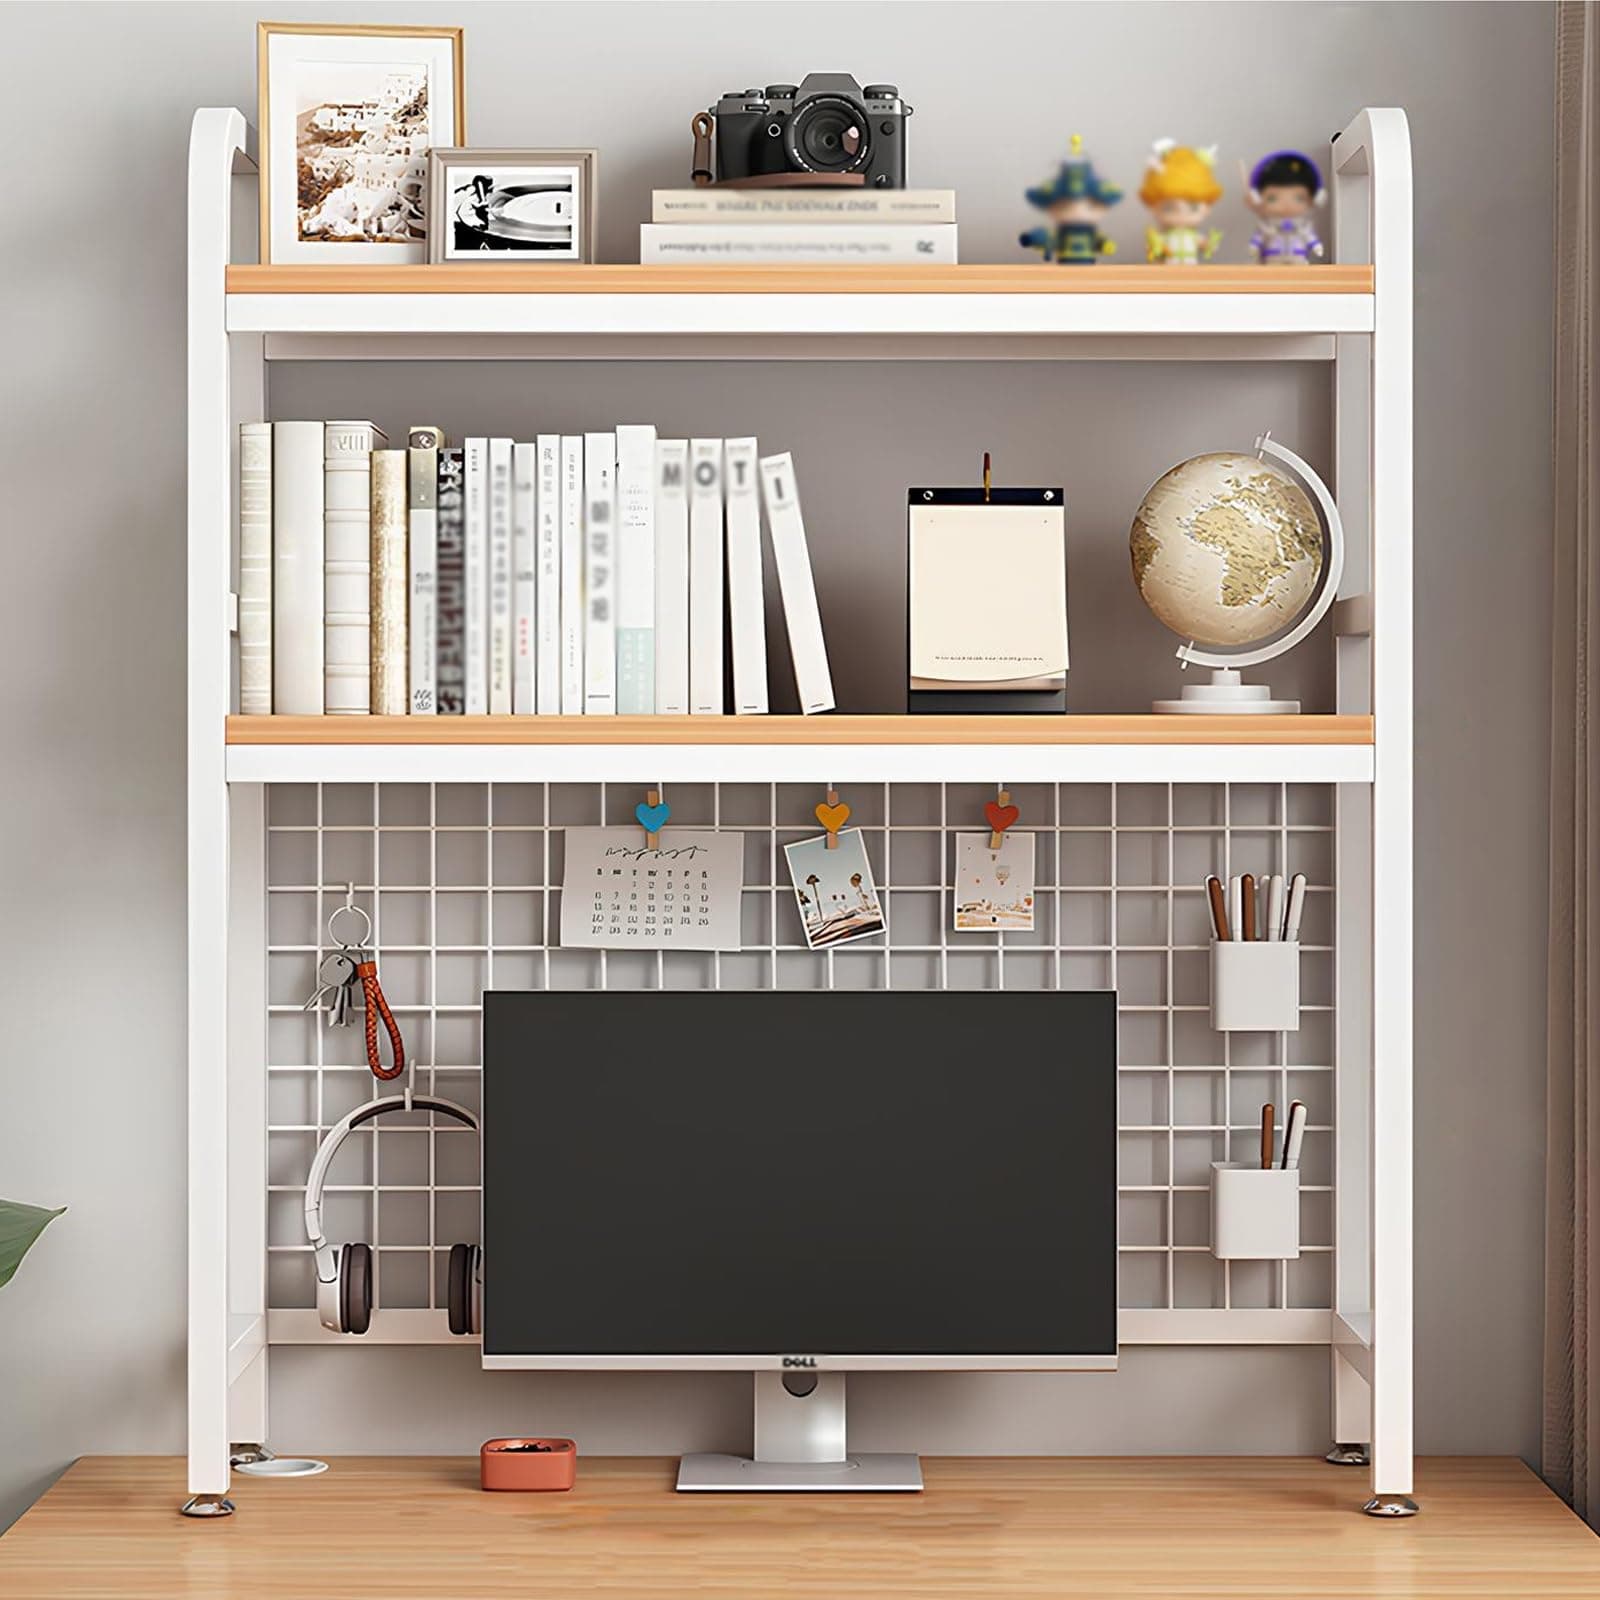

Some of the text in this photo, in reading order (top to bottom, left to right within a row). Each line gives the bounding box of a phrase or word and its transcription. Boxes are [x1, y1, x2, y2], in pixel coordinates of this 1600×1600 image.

[661, 462, 682, 487] M
[695, 461, 716, 487] O
[733, 461, 747, 486] T
